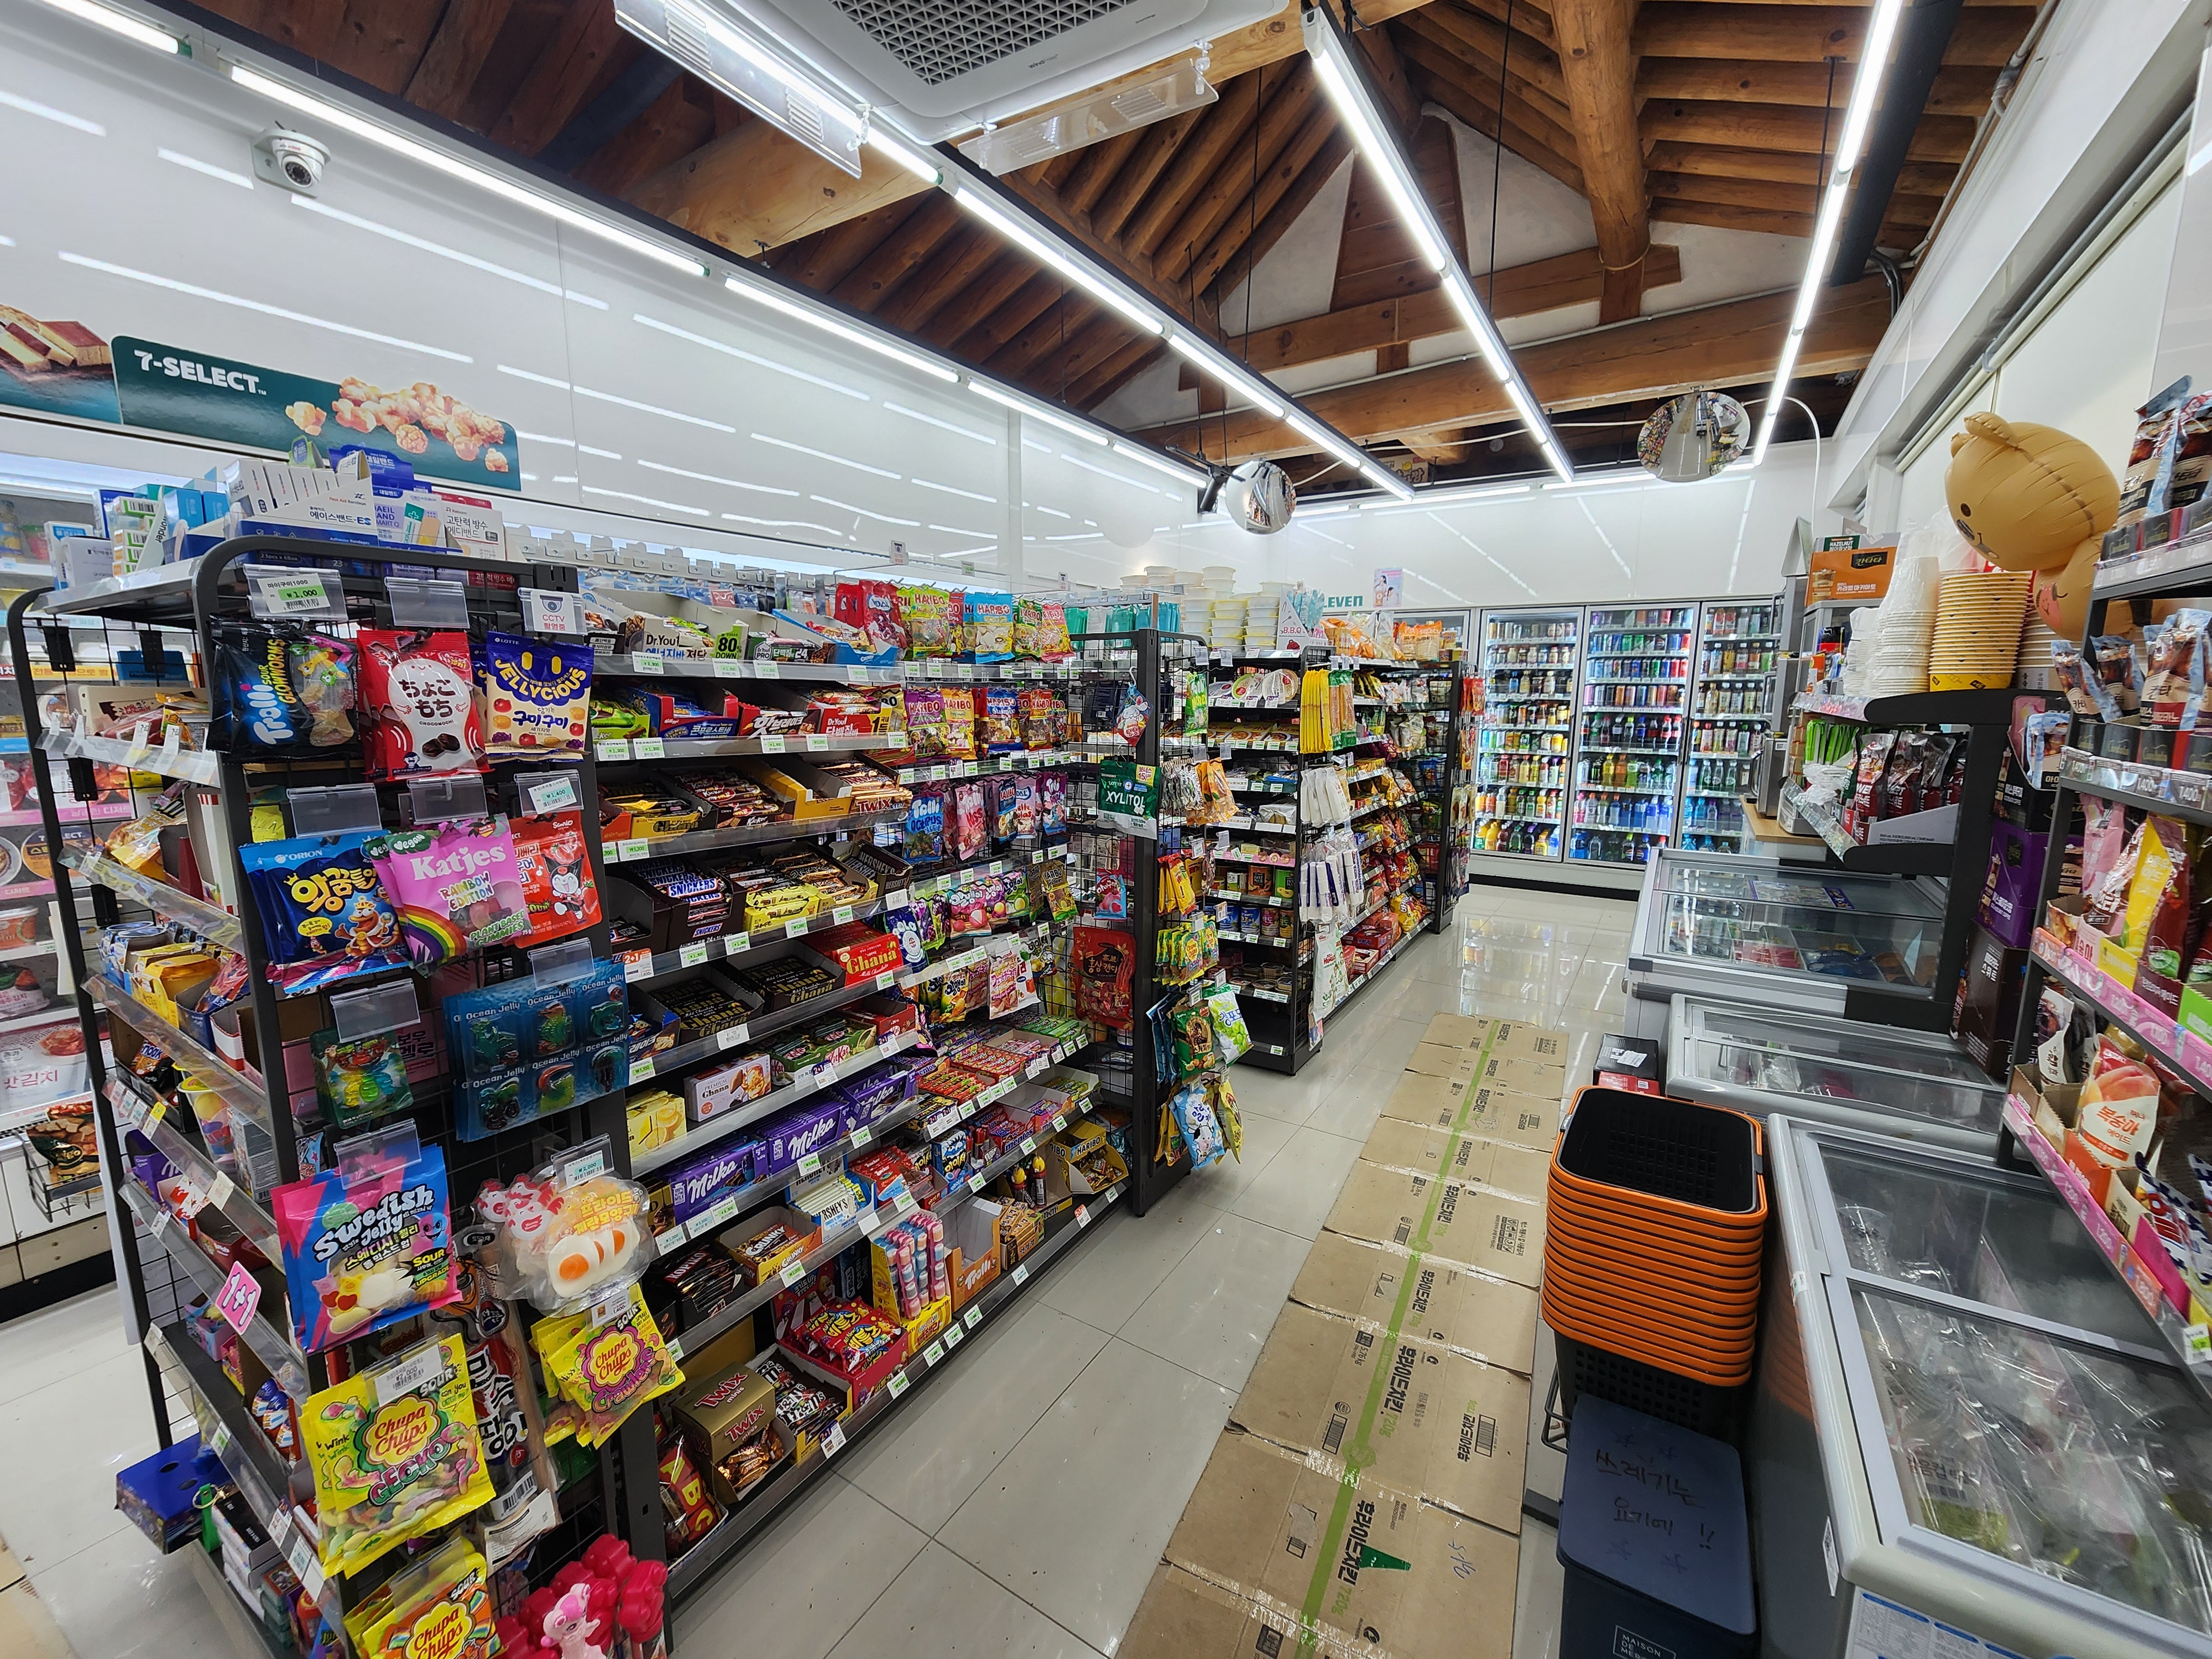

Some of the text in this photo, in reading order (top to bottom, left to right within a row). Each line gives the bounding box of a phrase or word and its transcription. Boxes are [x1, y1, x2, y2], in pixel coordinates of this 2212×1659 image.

[133, 349, 260, 394] 7-SELECT
[446, 517, 487, 530] 고탄력 방수
[1855, 555, 1884, 566] 칸타타
[267, 578, 309, 589] 마이구미1000
[914, 593, 946, 607] HARIBO
[977, 604, 1010, 615] HARIBO
[542, 614, 565, 622] CCTV
[499, 637, 519, 645] LOTTE
[718, 636, 738, 653] 80
[262, 664, 274, 686] SOUR
[398, 677, 456, 698] ちょこ
[240, 683, 295, 745] Trolli
[414, 697, 453, 718] もち
[909, 700, 940, 715] HARIBO
[943, 698, 972, 711] HARIBO
[512, 710, 568, 730] 구미구미
[690, 723, 732, 737] 콘푸로스트바
[856, 797, 891, 813] TWIX
[1104, 790, 1145, 811] XYLITOL
[288, 848, 323, 860] ORION
[413, 844, 507, 883] Katjes
[439, 871, 491, 900] RAINBOW
[669, 878, 716, 897] SNICKERS
[449, 885, 495, 911] EDITION
[693, 923, 722, 937] SNICKERS
[624, 953, 640, 964] 2+1
[846, 947, 898, 975] Ghana
[581, 972, 624, 992] Ocean Jelly
[526, 987, 576, 1006] Ocean Jelly
[465, 1000, 521, 1020] Ocean Jelly
[585, 1033, 628, 1053] Ocean Jelly
[531, 1048, 580, 1070] Ocean Jelly
[472, 1065, 526, 1088] Ocean Jelly
[702, 1084, 731, 1099] Ghana
[2096, 1105, 2140, 1135] 복숭아
[789, 1118, 837, 1160] Milka
[1004, 1127, 1034, 1151] mentos
[1076, 1135, 1101, 1156] HARIBO
[687, 1160, 739, 1202] Milka
[580, 1190, 632, 1217] 프라이드
[313, 1184, 436, 1260] Swedish
[745, 1223, 786, 1256] CRUNKY
[413, 1248, 446, 1267] SOUR
[665, 1251, 707, 1281] KOPIKO
[965, 1249, 992, 1290] Trolli
[221, 1272, 257, 1327] 1+1
[616, 1306, 639, 1331] SOUR
[595, 1338, 628, 1367] Chupa
[600, 1349, 636, 1382] Chups
[419, 1364, 456, 1397] SOUR
[695, 1372, 749, 1409] TWIX
[1385, 1345, 1417, 1414] 후라이드치킨
[726, 1386, 746, 1404] minis
[375, 1406, 426, 1438] Chupa
[724, 1404, 766, 1443] TWIX
[375, 1419, 429, 1457] Chups
[1457, 1413, 1475, 1463] 후라이드치킨
[1596, 1448, 1707, 1510] 쓰레기는
[1614, 1496, 1673, 1537] 요기에
[1337, 1499, 1376, 1586] 후라이드치킨
[451, 1569, 479, 1601] SOUR
[414, 1609, 460, 1651] Chupa
[1621, 1640, 1635, 1651] DE
[1622, 1633, 1661, 1657] MAISON
